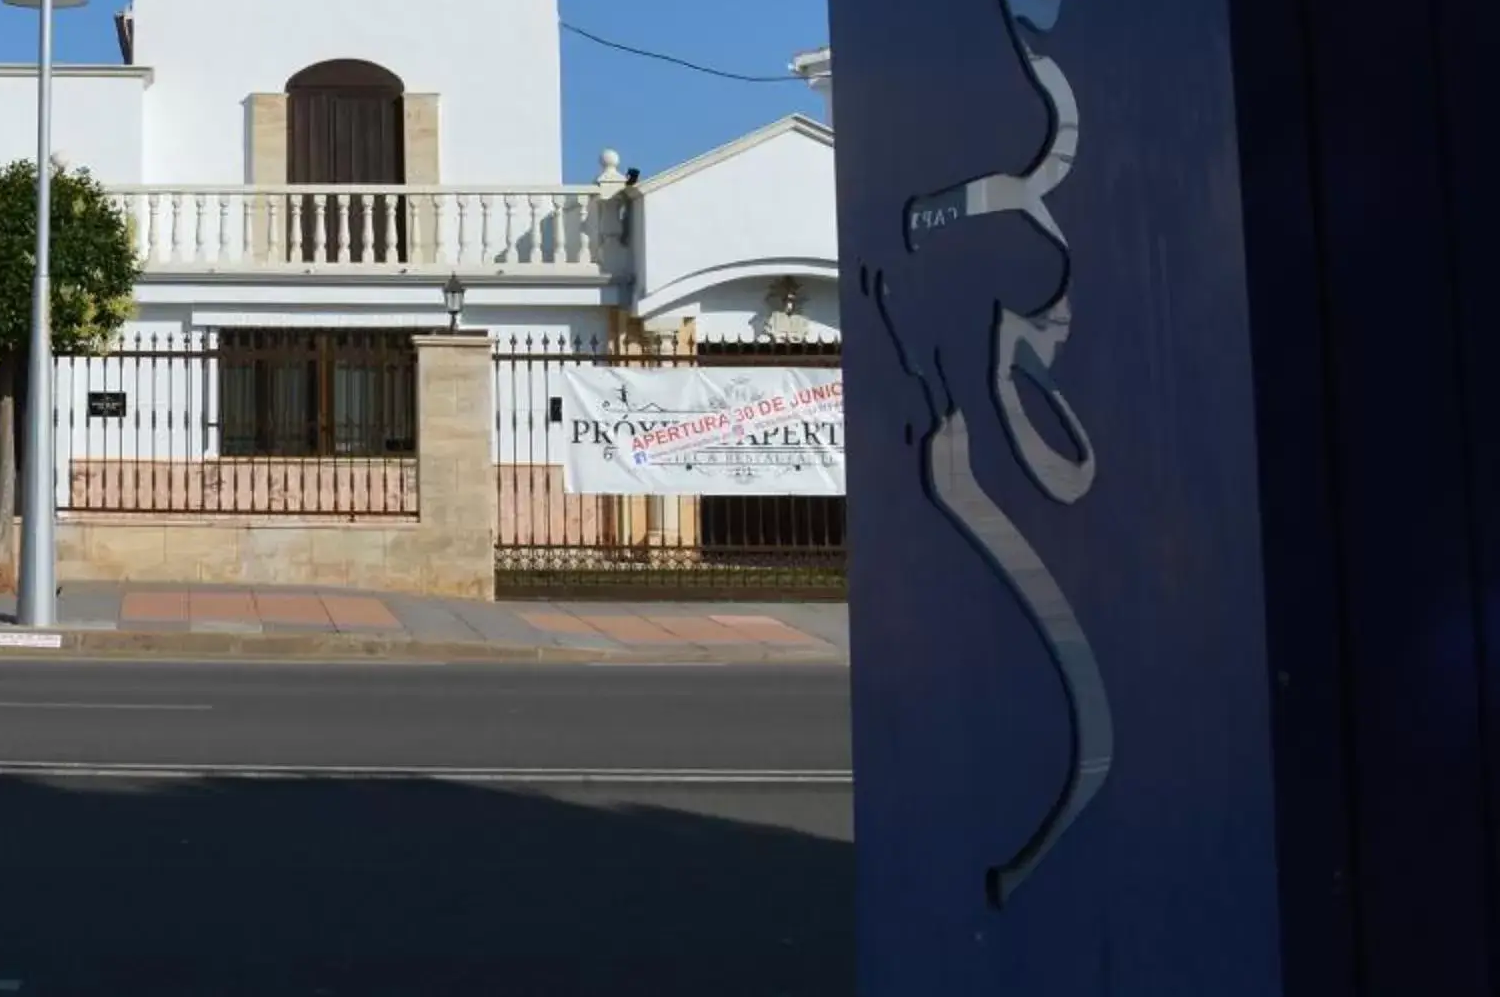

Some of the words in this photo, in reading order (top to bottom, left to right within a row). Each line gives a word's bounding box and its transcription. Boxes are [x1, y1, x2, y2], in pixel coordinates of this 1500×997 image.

[631, 413, 729, 451] APERTURA
[734, 406, 754, 422] 30
[758, 396, 785, 416] DE
